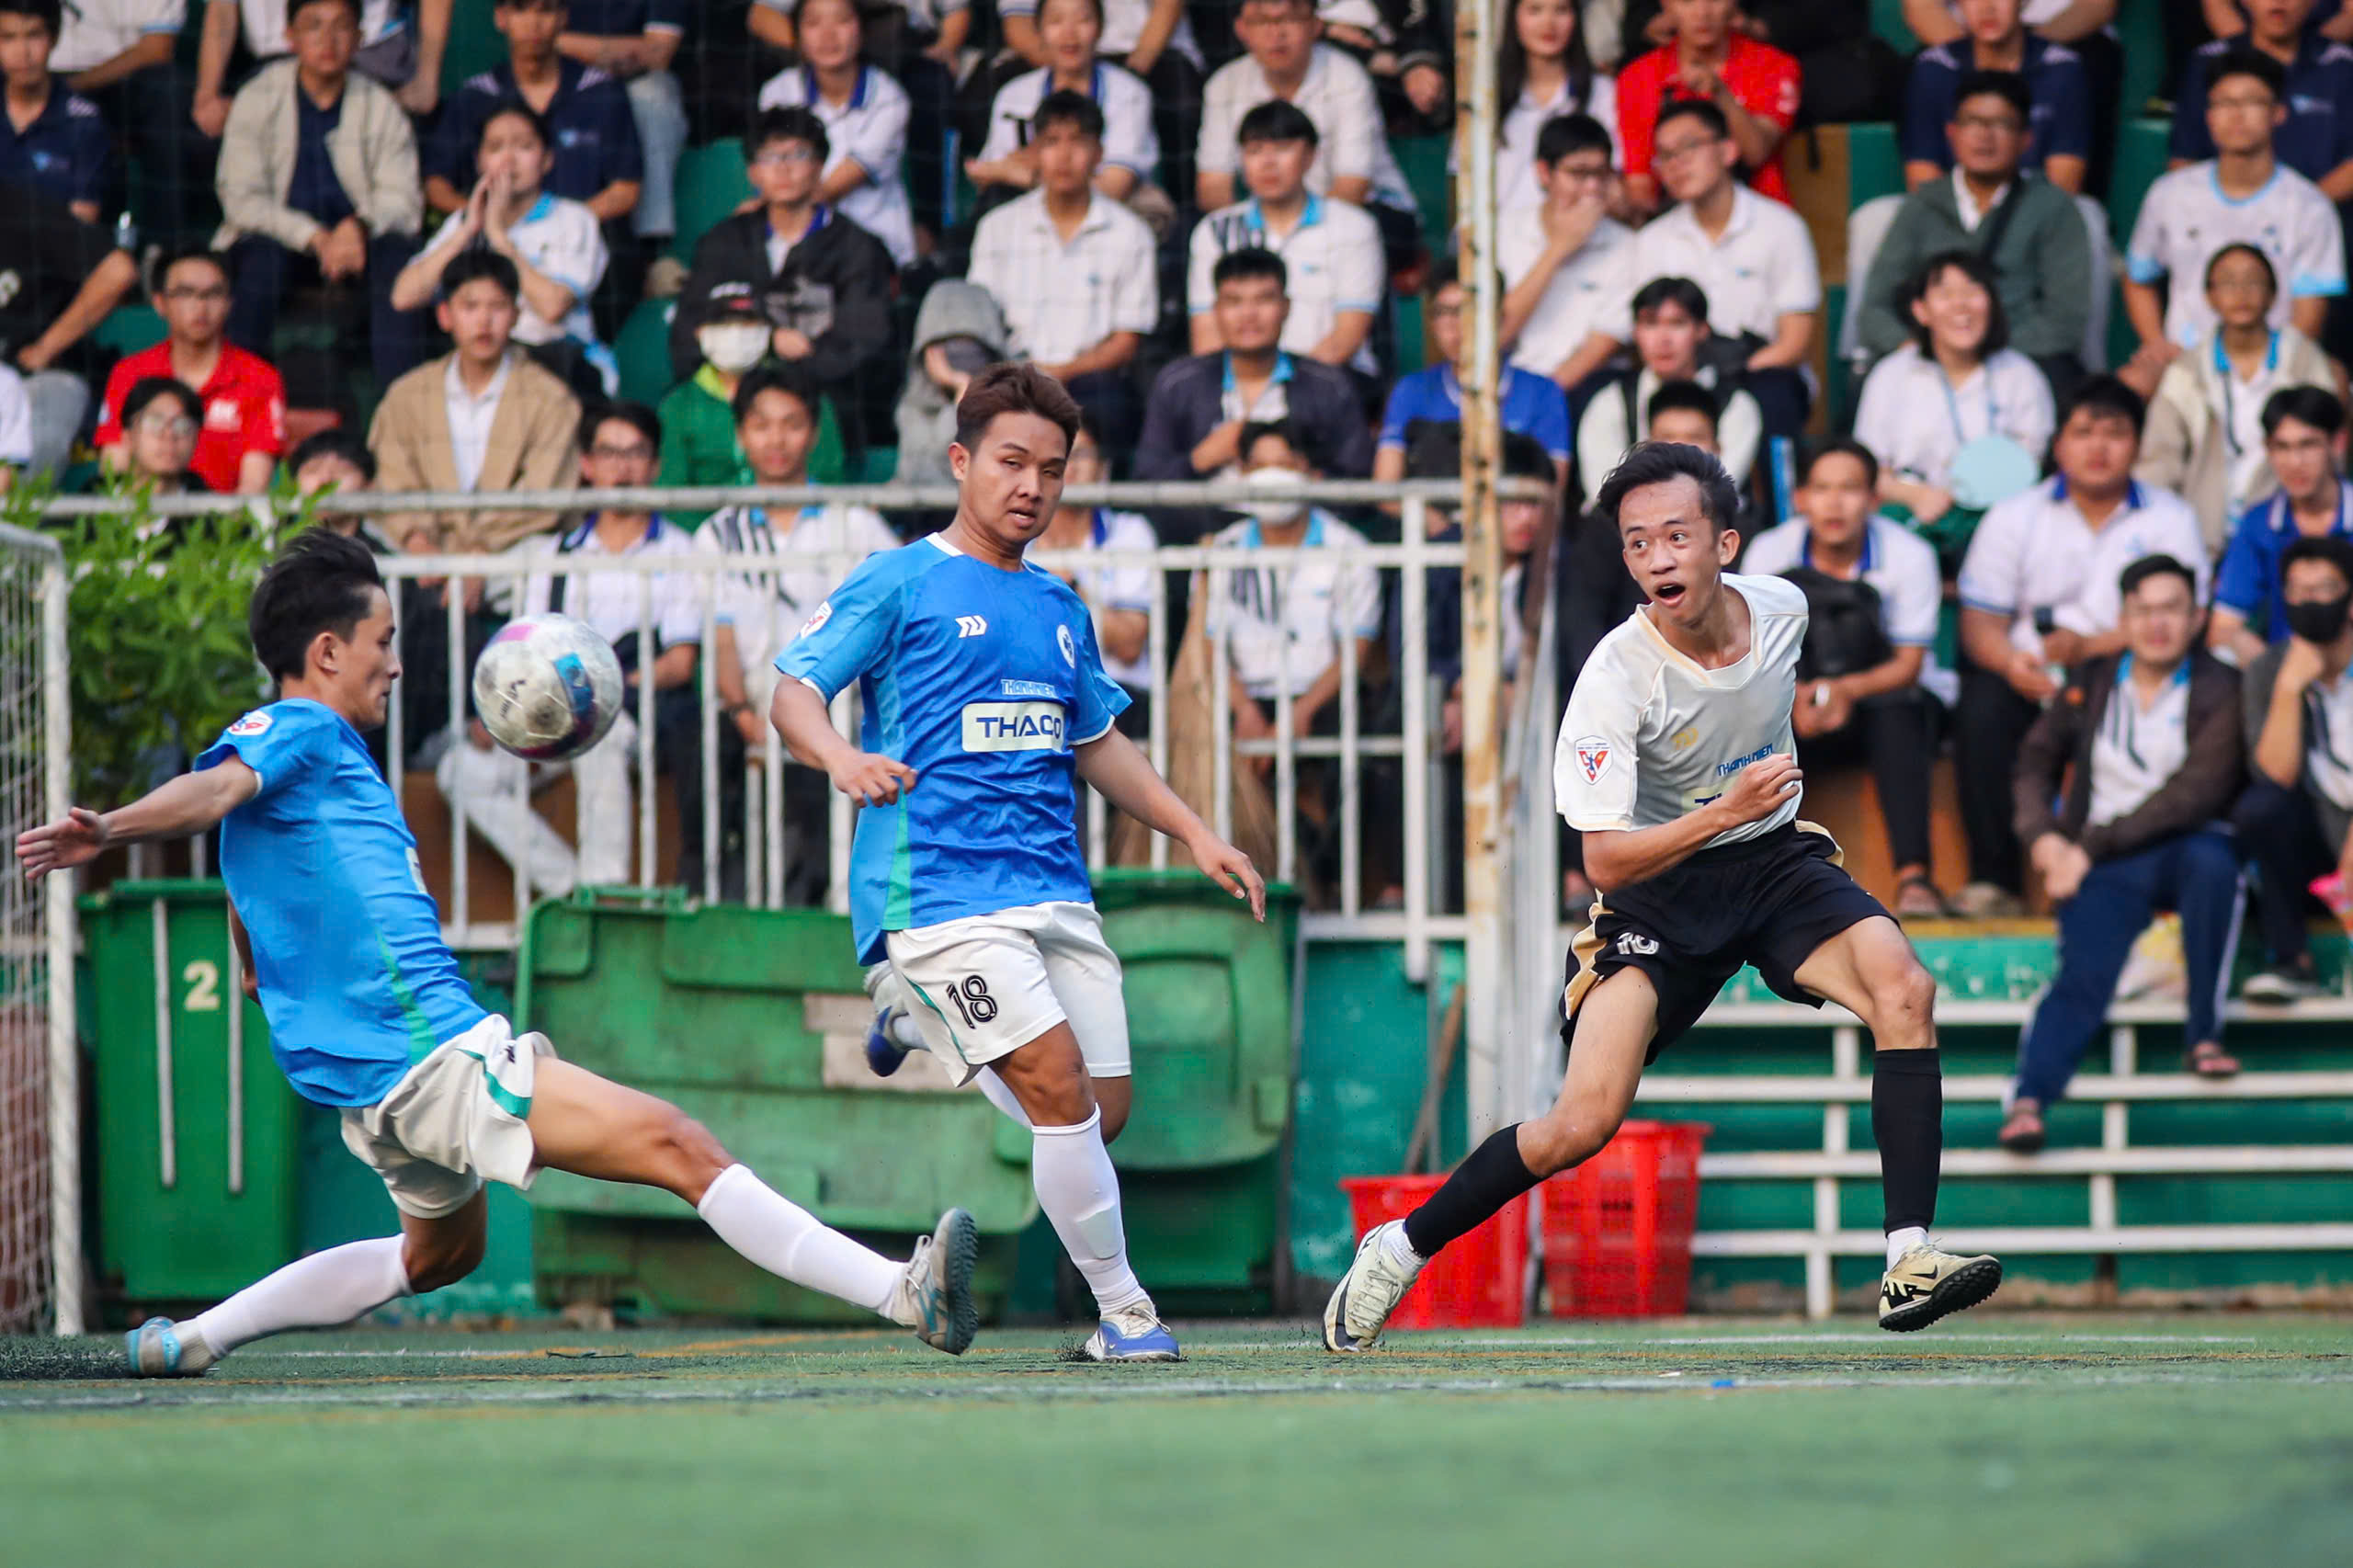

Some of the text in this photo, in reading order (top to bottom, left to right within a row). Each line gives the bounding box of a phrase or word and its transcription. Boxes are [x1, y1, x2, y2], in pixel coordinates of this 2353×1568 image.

[976, 714, 1062, 739] THACO
[184, 960, 221, 1012] 2
[946, 974, 997, 1029] 18
